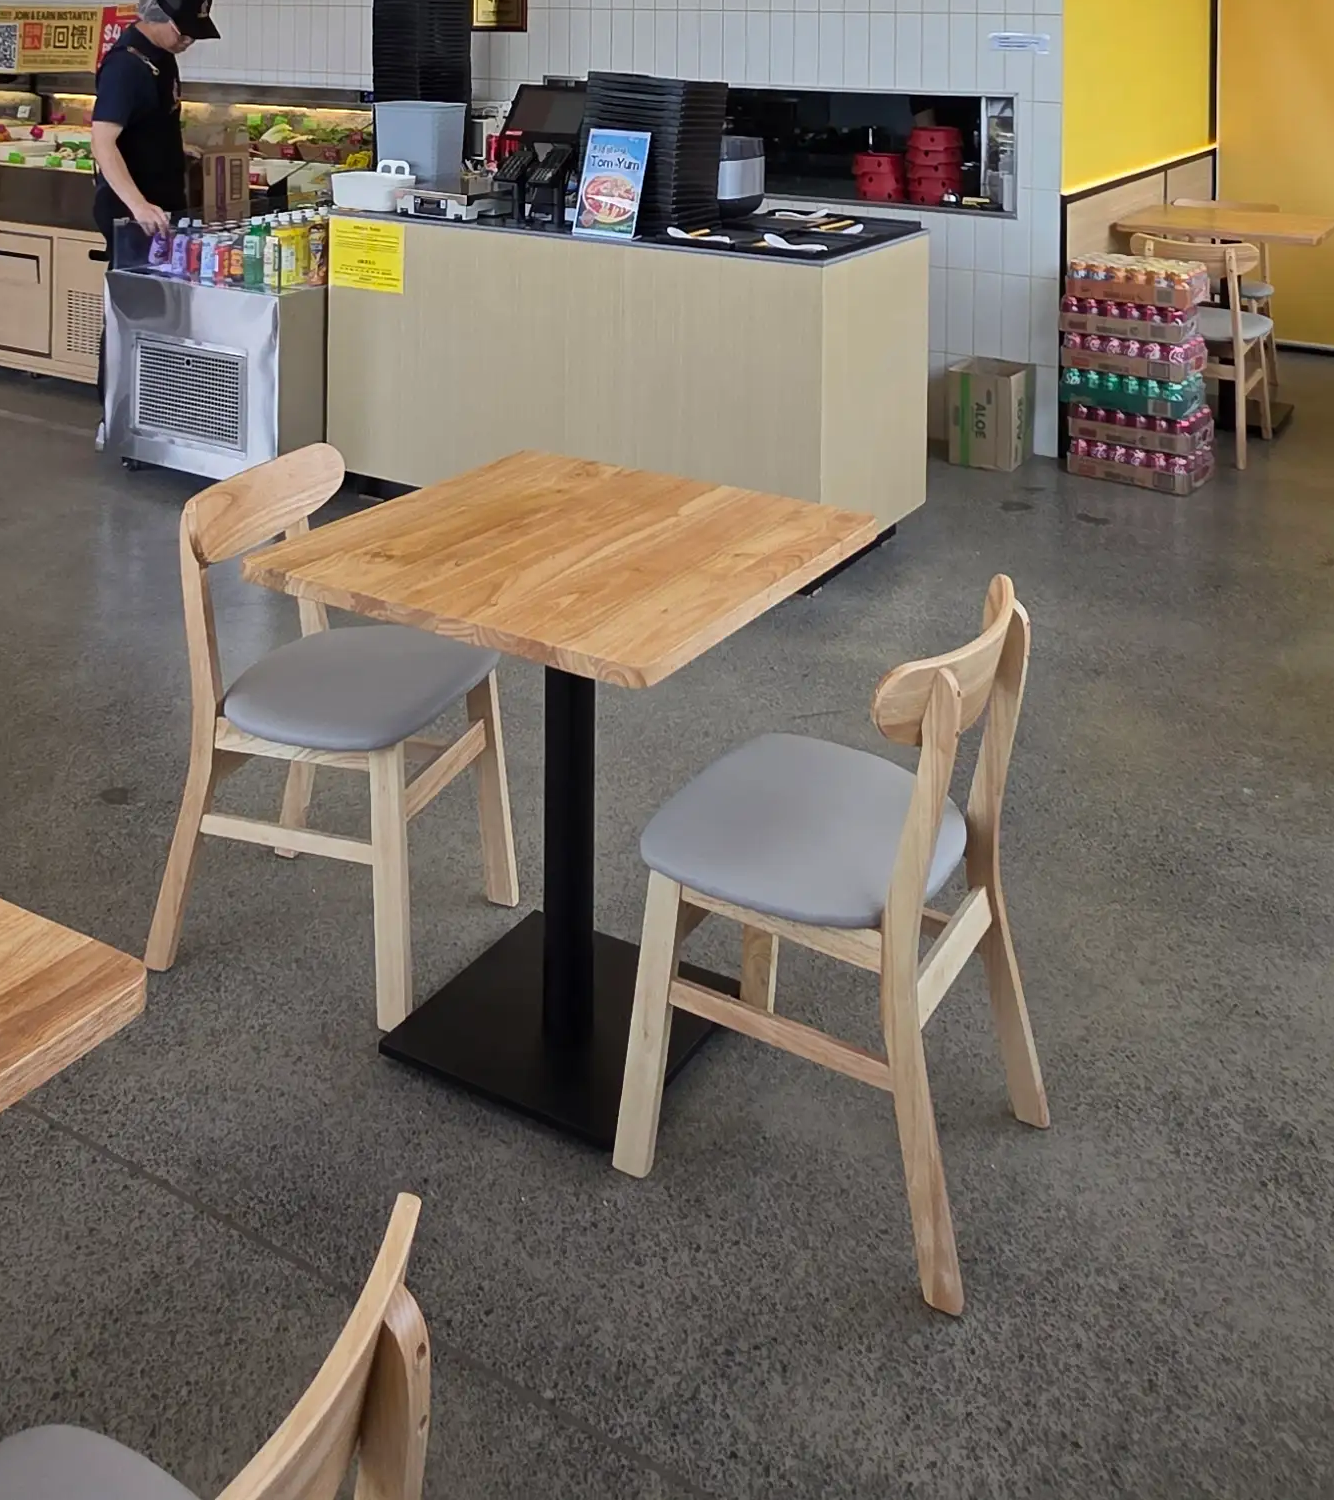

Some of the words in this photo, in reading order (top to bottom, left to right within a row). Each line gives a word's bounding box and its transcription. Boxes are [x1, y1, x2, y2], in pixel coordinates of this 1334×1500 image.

[14, 11, 29, 20] JOIN
[36, 11, 55, 20] EARN
[975, 402, 986, 439] ALOE
